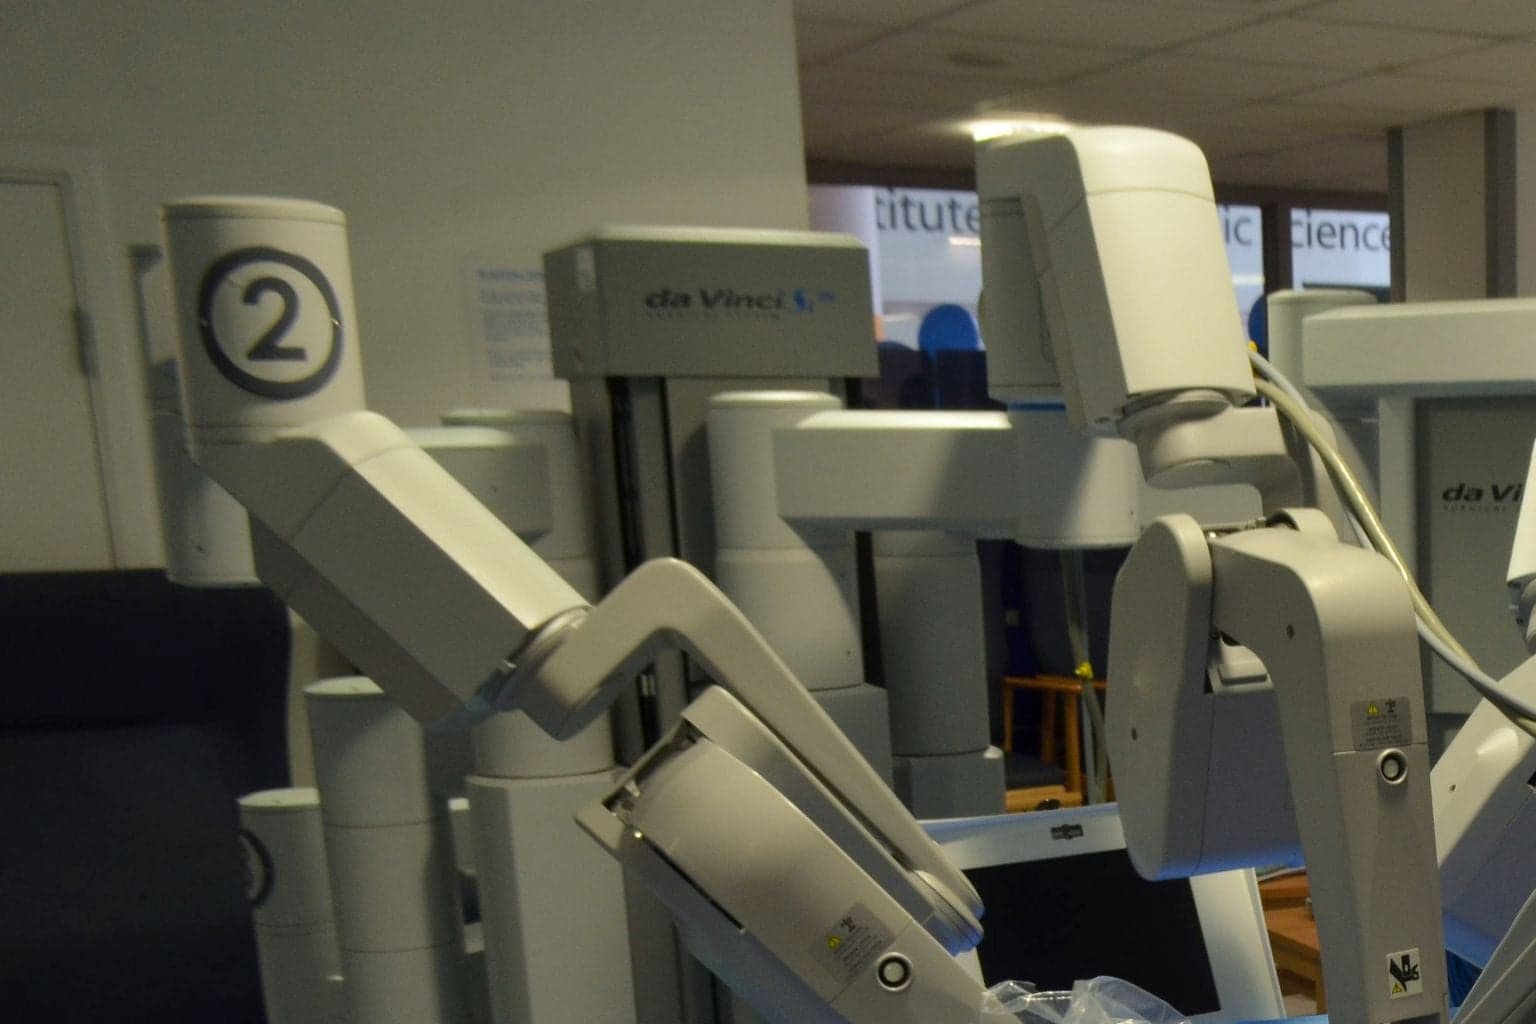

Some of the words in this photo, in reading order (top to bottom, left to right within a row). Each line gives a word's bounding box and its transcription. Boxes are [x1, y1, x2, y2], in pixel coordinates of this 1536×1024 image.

[645, 288, 692, 309] da
[699, 287, 784, 309] Vinci
[242, 277, 307, 361] 2
[1442, 483, 1484, 501] da
